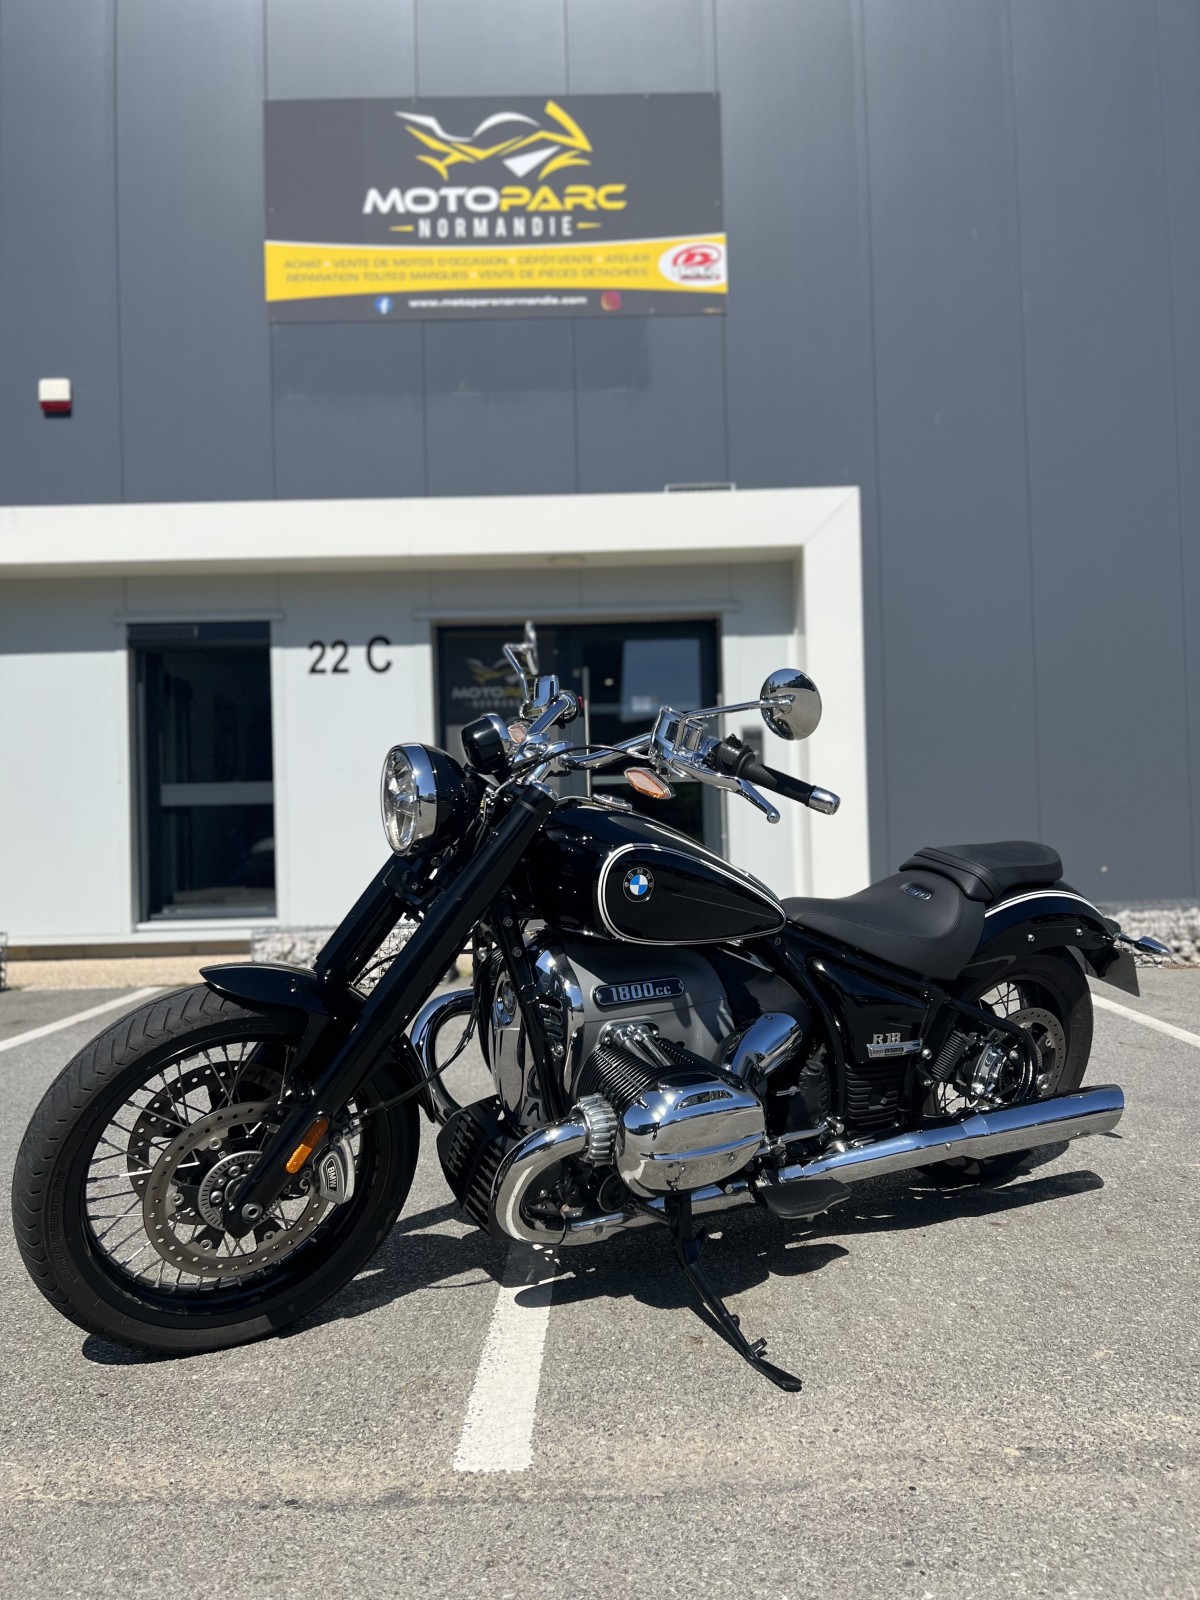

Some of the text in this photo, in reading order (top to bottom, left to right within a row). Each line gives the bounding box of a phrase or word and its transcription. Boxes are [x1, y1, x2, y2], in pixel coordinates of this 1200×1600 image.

[362, 183, 627, 214] MOTOPARC
[418, 216, 574, 239] NORMANDIE
[283, 260, 323, 269] ACHAT
[333, 259, 370, 268] VENTE
[373, 258, 389, 267] DE
[392, 257, 434, 267] MOTOS
[604, 254, 650, 264] ATELIER
[362, 271, 407, 281] TOUTES
[409, 270, 468, 281] MARQUES
[478, 269, 515, 279] VENTE
[519, 269, 534, 279] DE
[408, 295, 588, 308] www.motoparcnormandie.com
[308, 635, 393, 674] 22 C
[609, 982, 672, 1001] 1800cc
[327, 1166, 337, 1188] BMW
